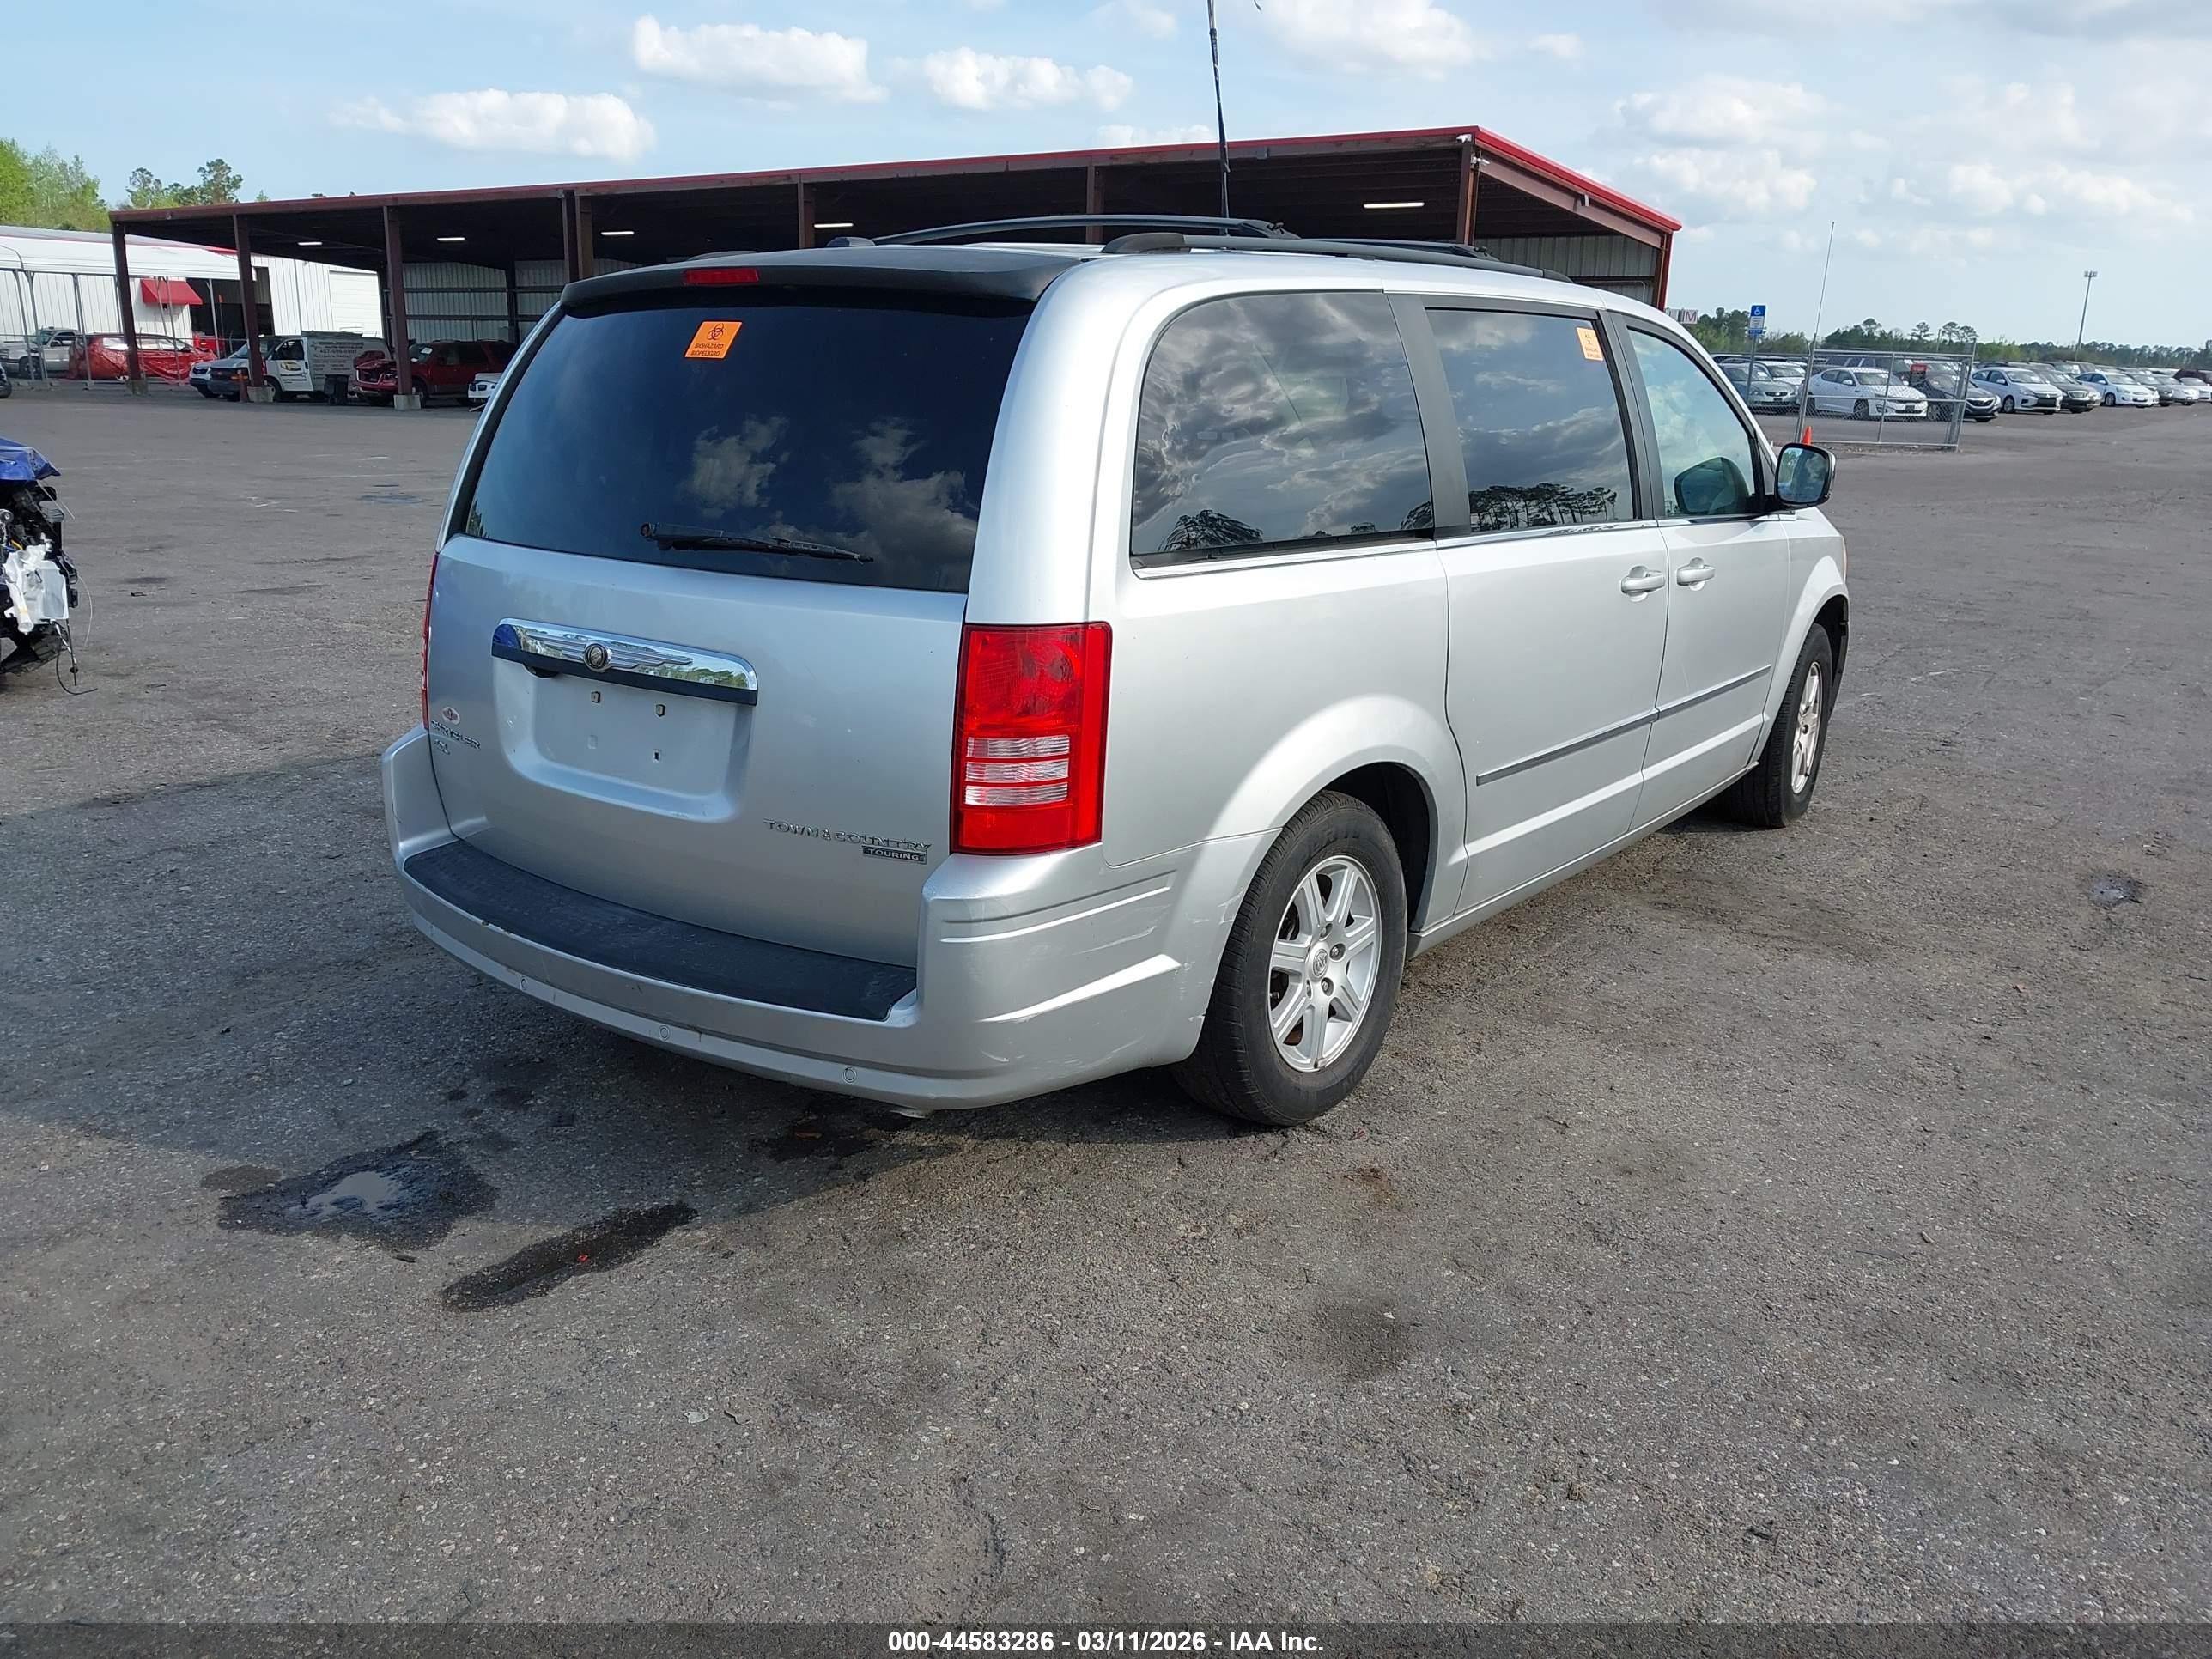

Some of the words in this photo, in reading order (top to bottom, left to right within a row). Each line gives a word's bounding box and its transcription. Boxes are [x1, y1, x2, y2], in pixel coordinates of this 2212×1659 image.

[763, 817, 818, 838] TOWN
[835, 830, 932, 851] COUNTRY
[868, 848, 920, 861] TOURING
